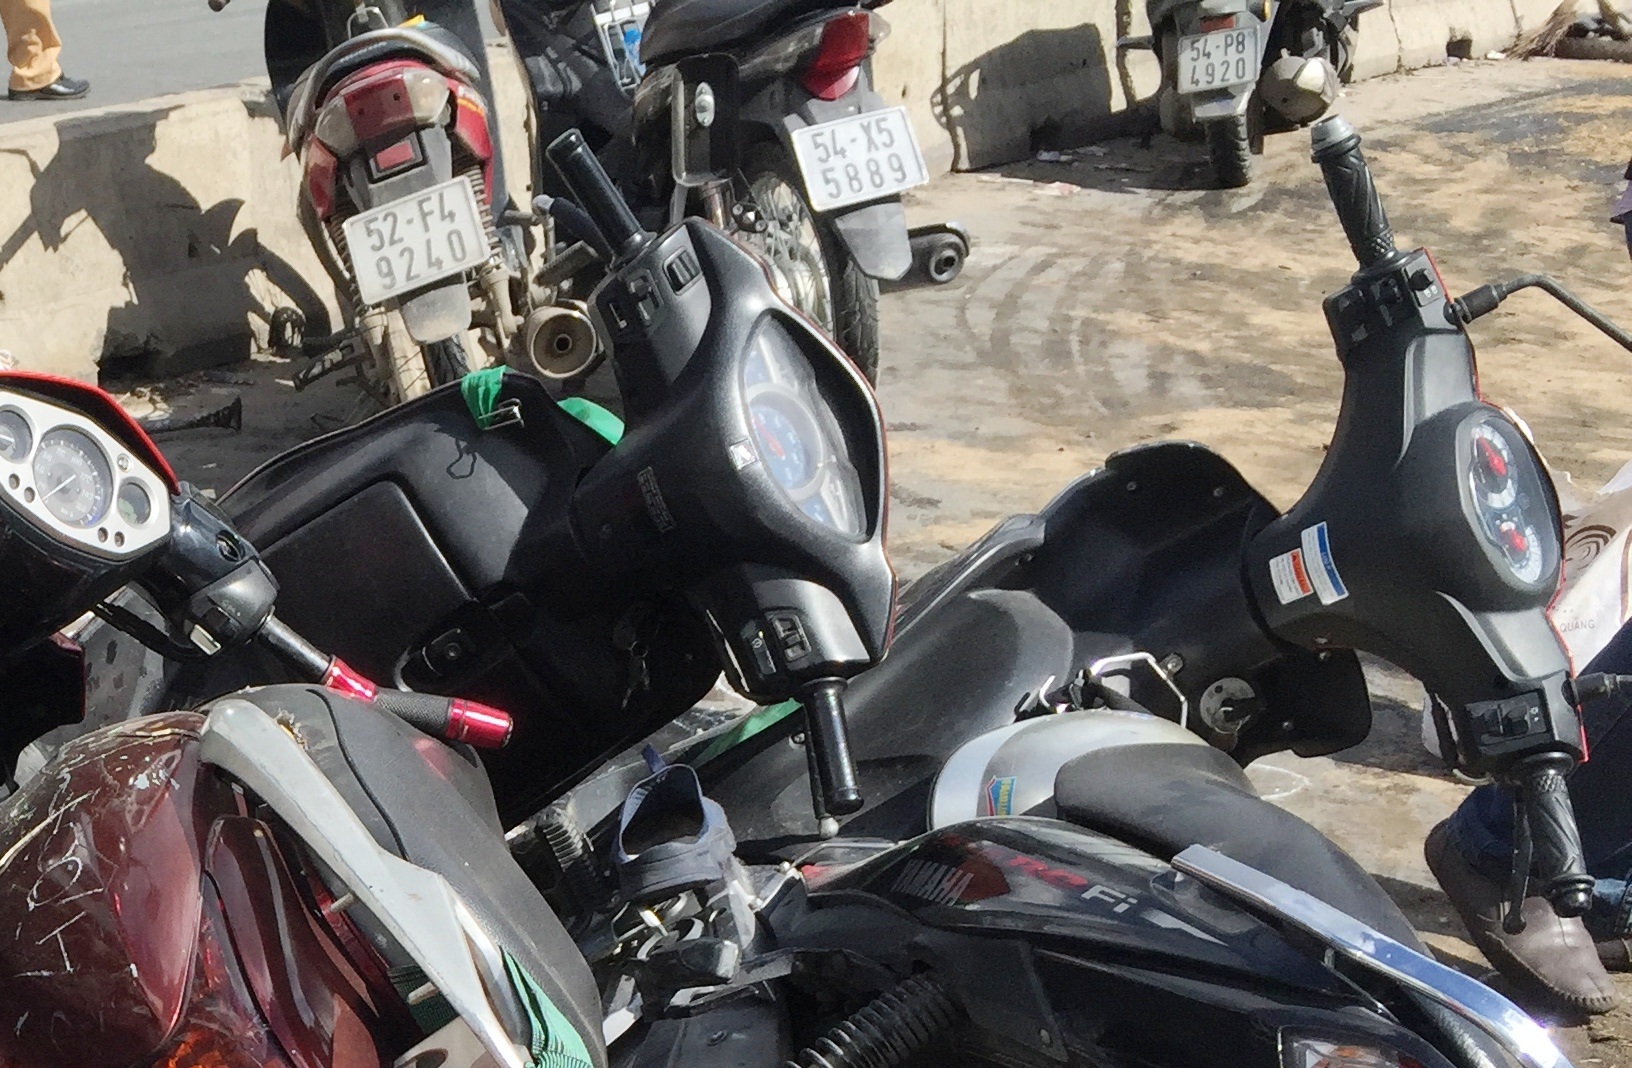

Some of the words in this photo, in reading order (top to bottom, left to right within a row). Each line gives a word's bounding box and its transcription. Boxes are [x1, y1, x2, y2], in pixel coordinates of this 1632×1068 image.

[1190, 32, 1247, 60] 54-P8
[1190, 55, 1247, 87] 4920
[810, 116, 895, 162] 54-X5
[824, 153, 907, 199] 5889
[364, 196, 458, 252] 52-F4
[376, 233, 468, 290] 9240
